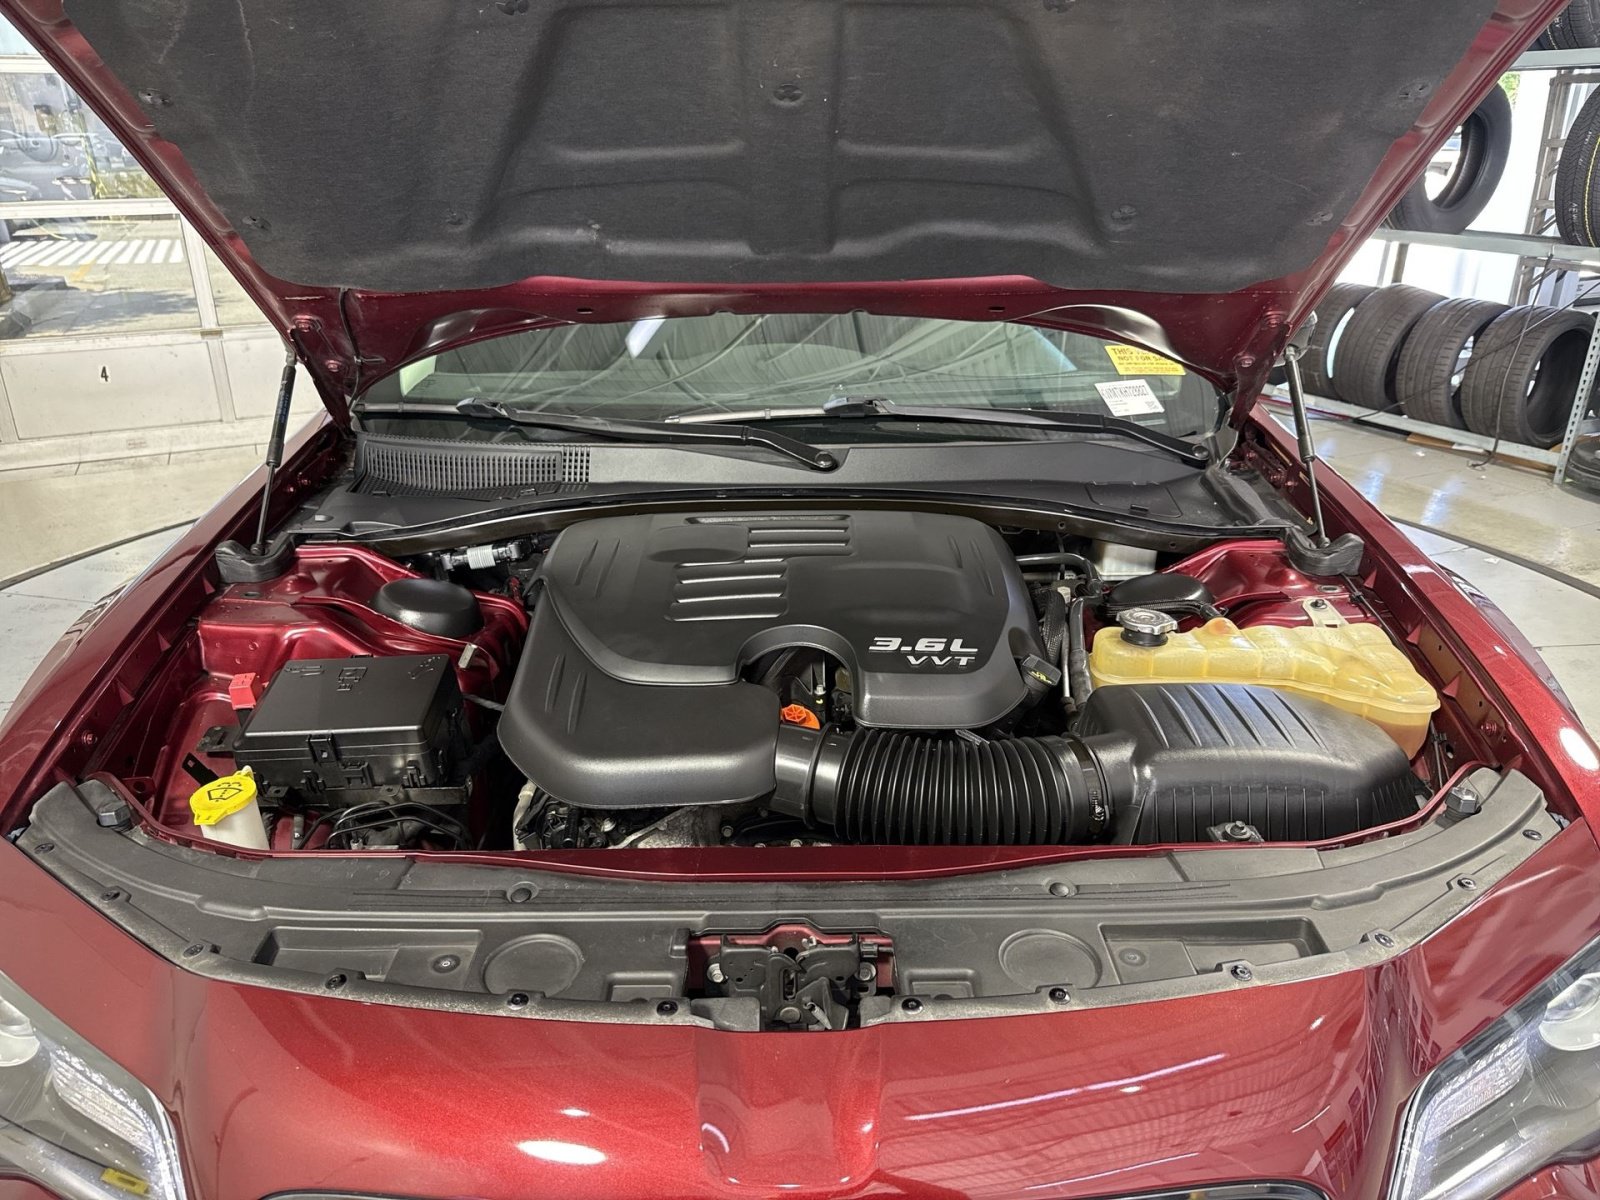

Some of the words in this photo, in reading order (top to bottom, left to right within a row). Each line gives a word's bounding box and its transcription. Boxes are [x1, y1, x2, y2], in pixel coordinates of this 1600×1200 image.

[100, 365, 109, 382] 4
[868, 637, 979, 653] 3.6L
[906, 655, 976, 667] VVT
